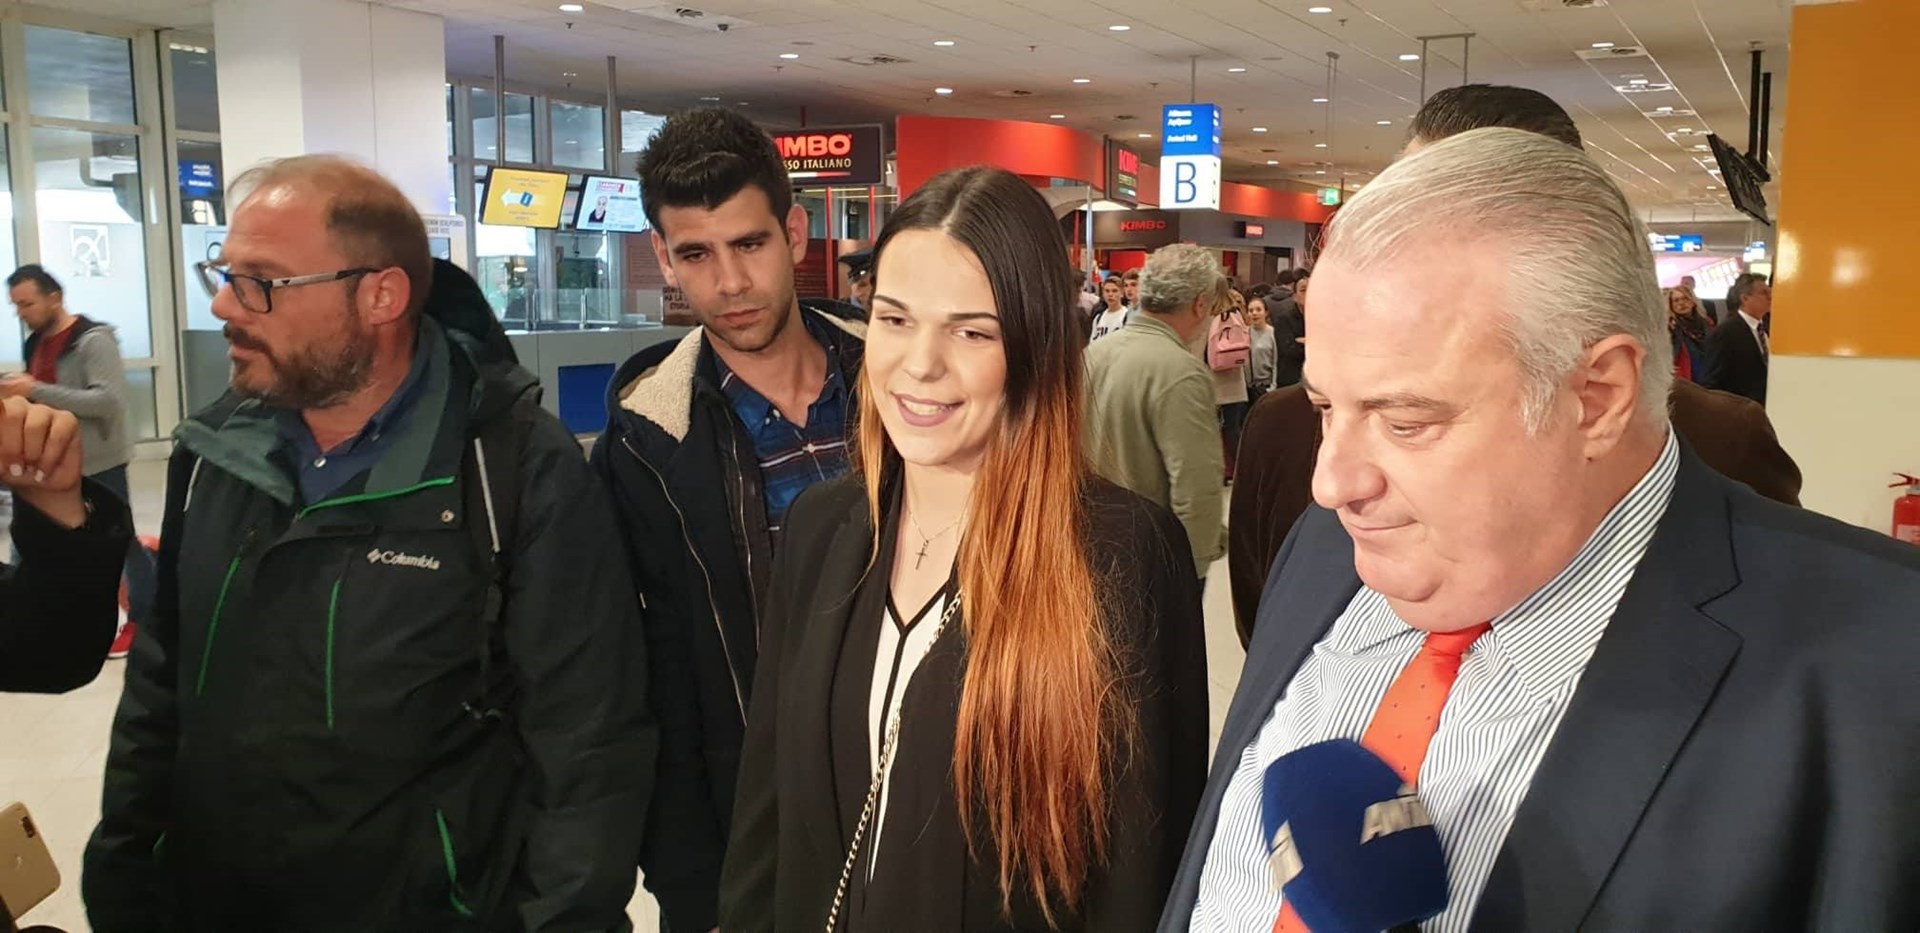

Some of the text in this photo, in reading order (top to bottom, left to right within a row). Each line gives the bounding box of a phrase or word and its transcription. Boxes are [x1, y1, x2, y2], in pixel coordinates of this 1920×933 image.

[803, 158, 852, 169] ITALIANO
[1174, 161, 1197, 203] B
[1119, 221, 1167, 231] KIMBO
[380, 550, 440, 570] Columbia
